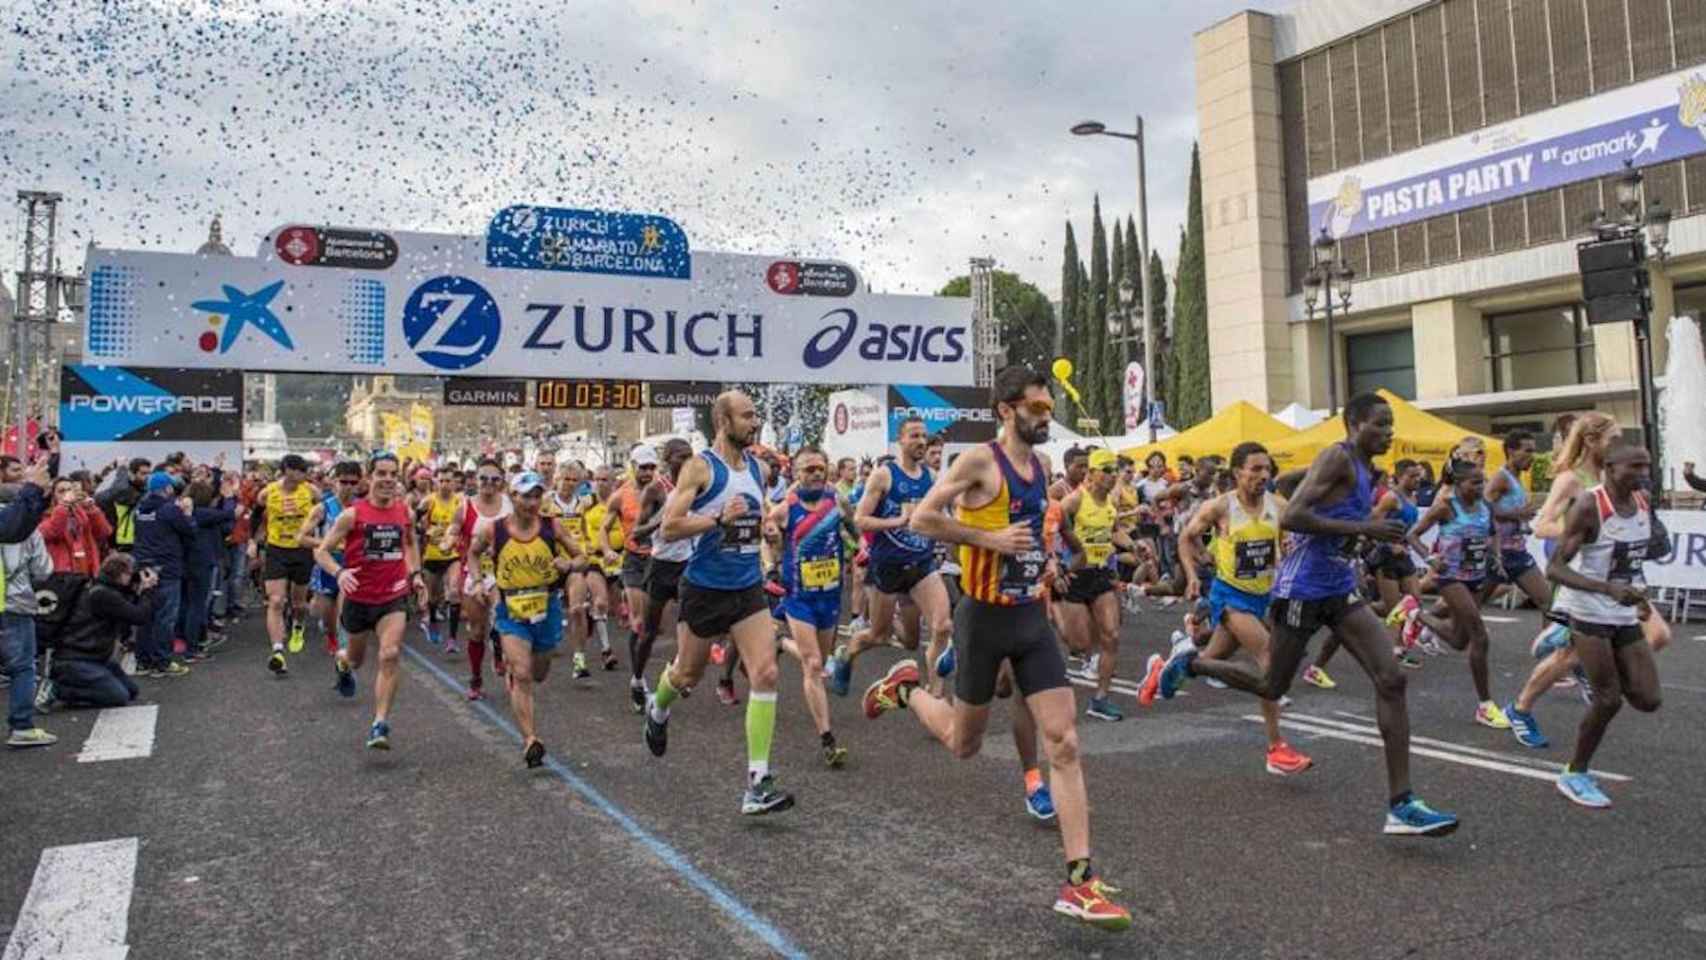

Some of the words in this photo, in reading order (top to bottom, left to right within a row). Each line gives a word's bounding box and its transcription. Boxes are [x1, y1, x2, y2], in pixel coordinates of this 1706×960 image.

[1367, 181, 1444, 221] PASTA
[1449, 154, 1534, 200] PARTY
[1542, 148, 1560, 162] BY
[1561, 131, 1638, 166] aramark
[542, 215, 609, 235] ZURICH
[325, 247, 385, 260] Barcelona
[571, 252, 666, 273] BARCELONA
[522, 303, 765, 358] ZURICH
[858, 322, 967, 363] asics
[69, 394, 238, 413] POWERADE
[449, 389, 519, 403] GARMIN
[653, 392, 716, 405] GARMIN
[893, 405, 996, 422] POWERADE
